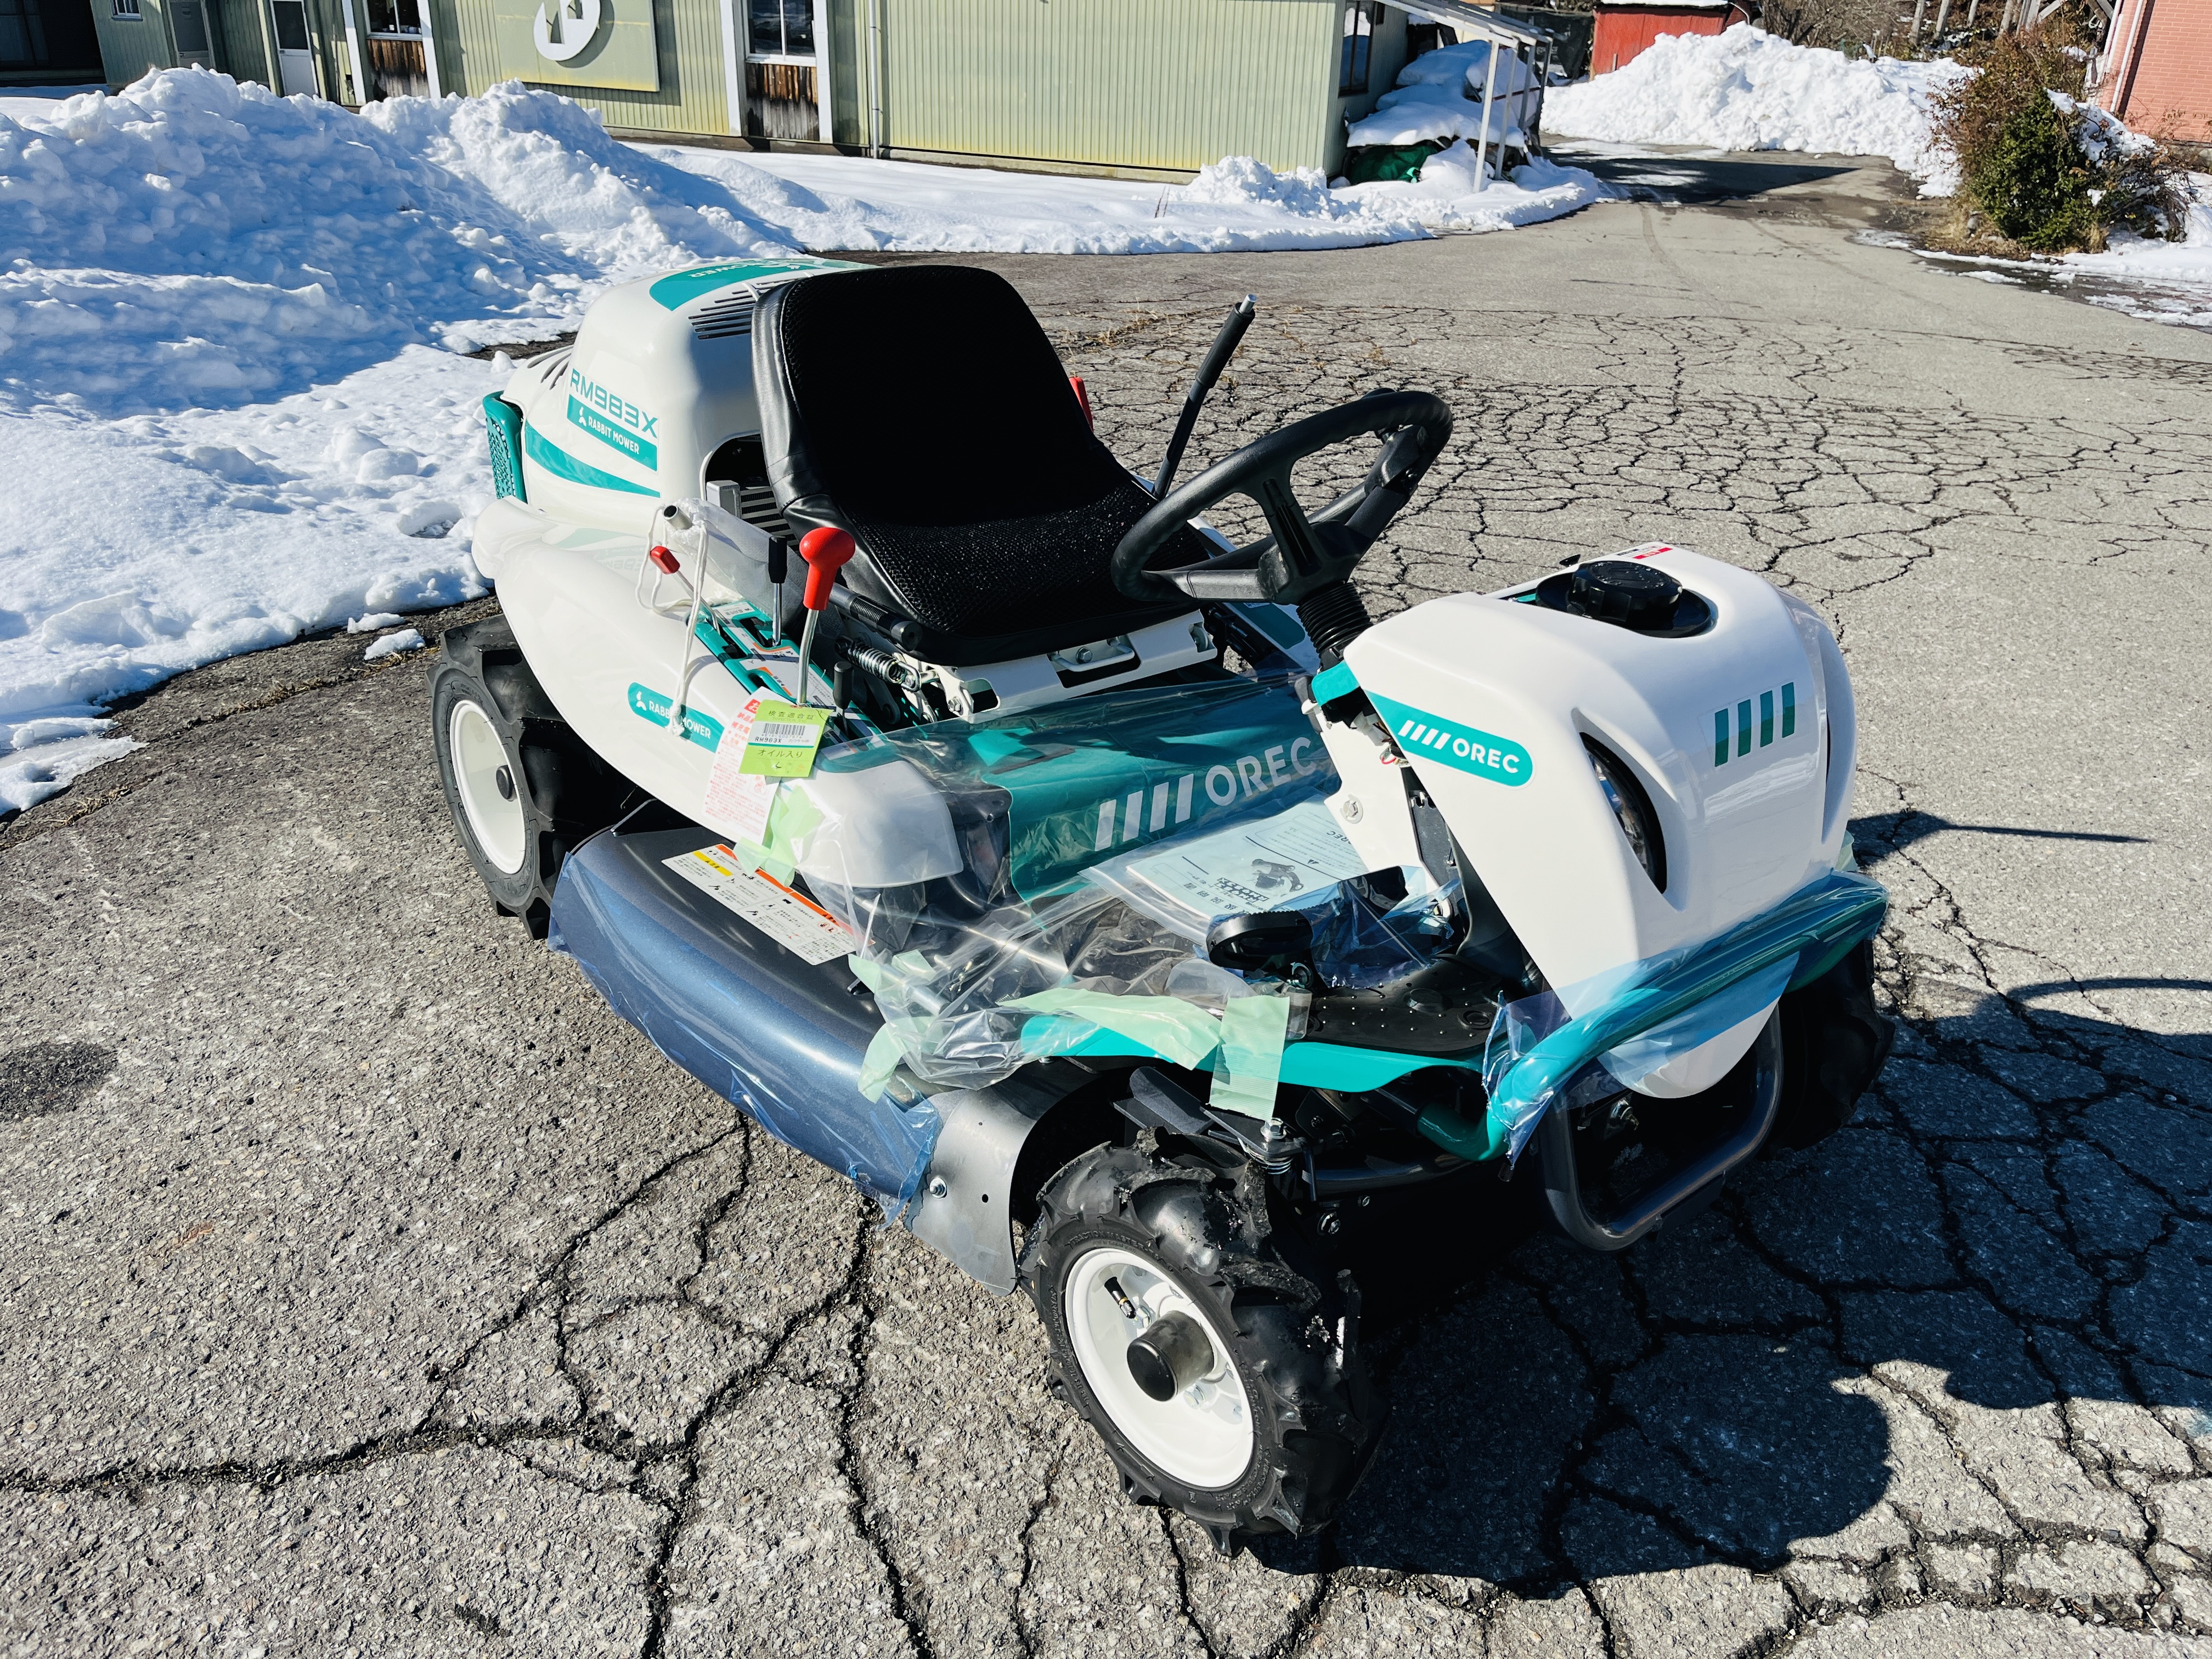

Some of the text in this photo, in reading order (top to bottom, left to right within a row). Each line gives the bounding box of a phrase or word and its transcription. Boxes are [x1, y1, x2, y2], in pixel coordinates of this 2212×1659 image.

[570, 368, 658, 439] RM983X
[588, 416, 640, 455] RABBIT MOWER
[648, 700, 670, 719] RABB
[758, 749, 803, 758] オイル入り
[1205, 737, 1317, 806] OREC
[1452, 738, 1520, 774] OREC
[1326, 830, 1352, 845] REC
